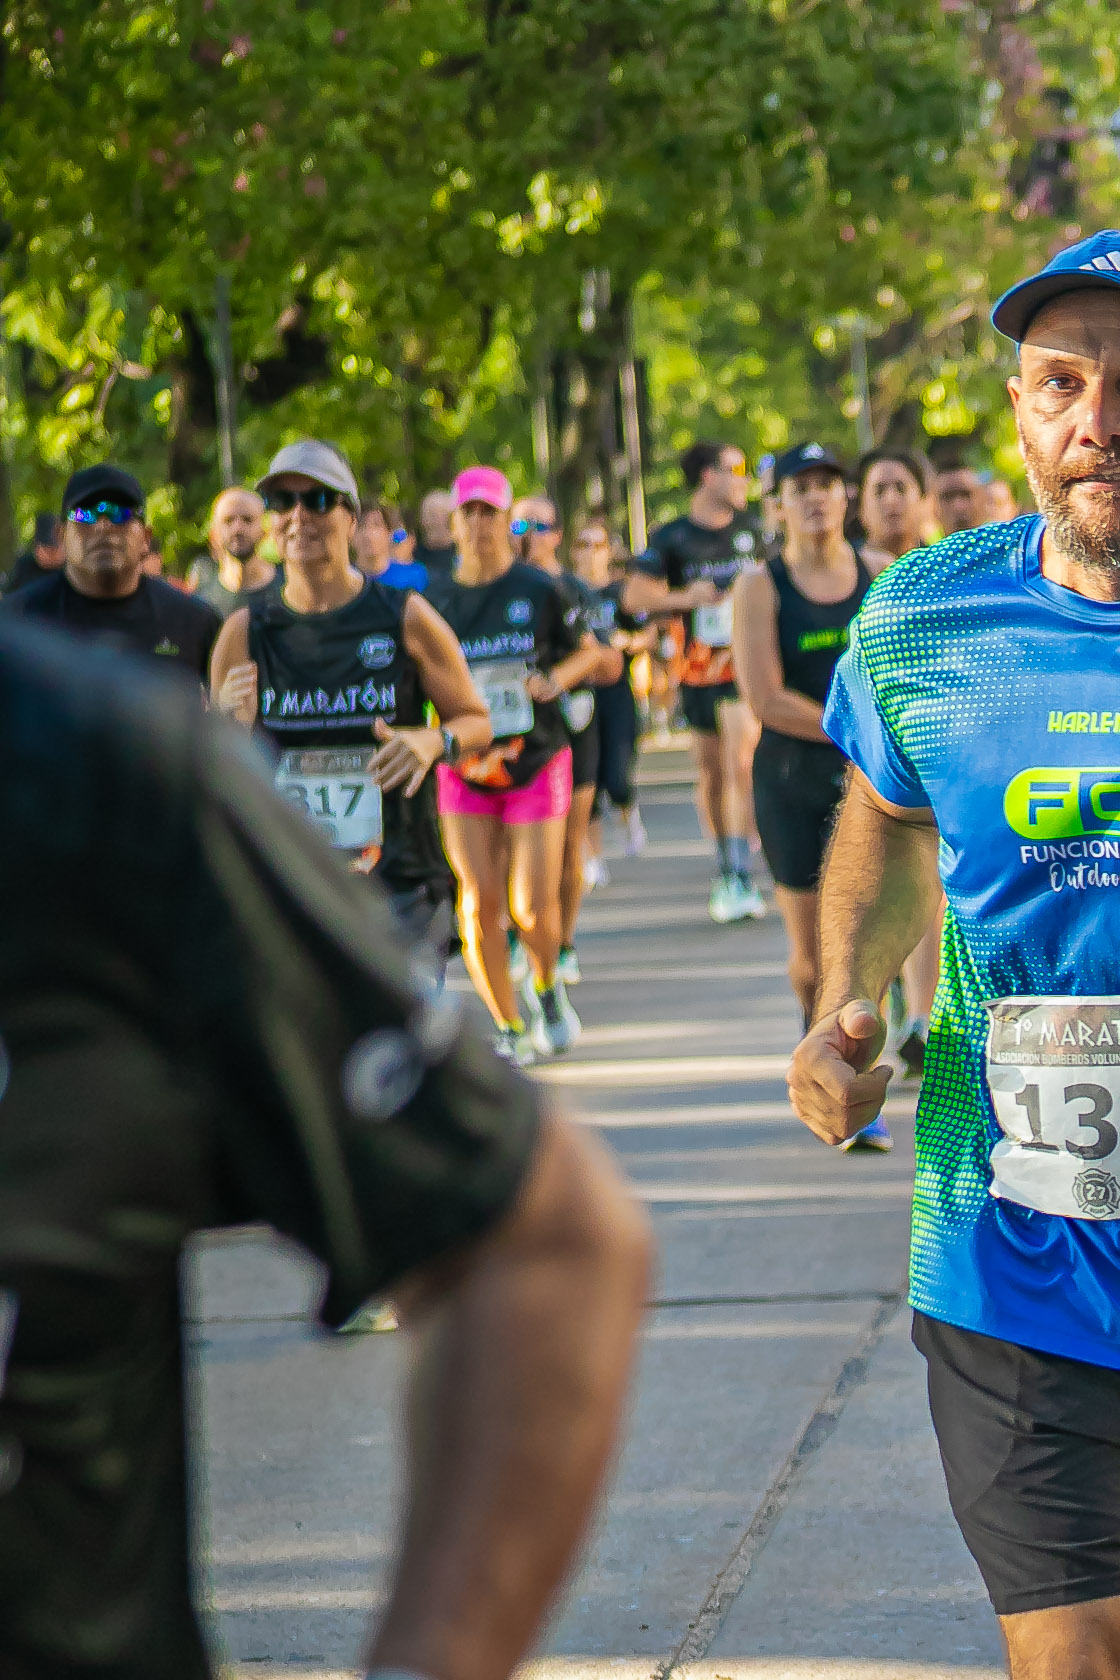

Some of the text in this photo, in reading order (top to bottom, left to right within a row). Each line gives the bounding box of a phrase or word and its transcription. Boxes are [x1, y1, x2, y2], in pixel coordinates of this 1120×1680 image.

[279, 676, 396, 716] MARATÓN
[1042, 1052, 1089, 1065] BOMBEROS
[1085, 1183, 1106, 1201] 27
